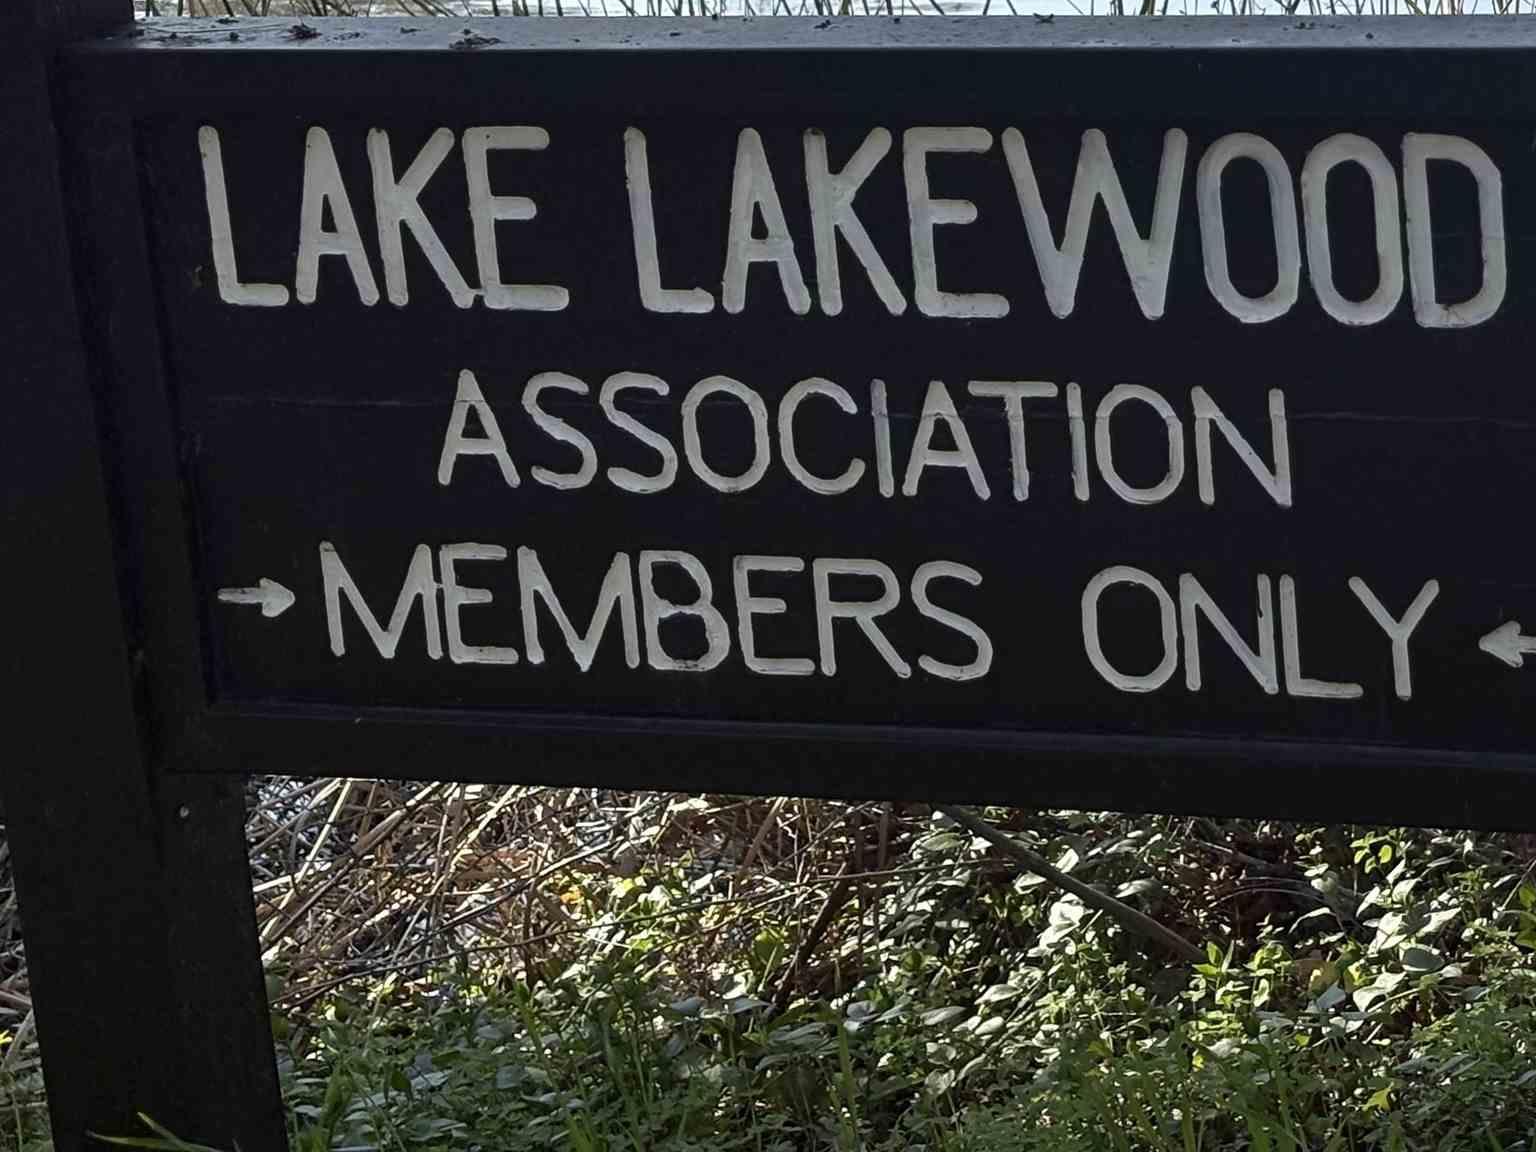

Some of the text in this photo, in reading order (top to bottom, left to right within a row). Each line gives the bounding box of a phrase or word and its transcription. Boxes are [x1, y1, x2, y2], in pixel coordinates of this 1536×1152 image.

[198, 125, 1507, 329] LAKE LAKEWOOD
[437, 368, 1293, 508] ASSOCIATION
[318, 540, 1441, 701] MEMBERS ONLY
